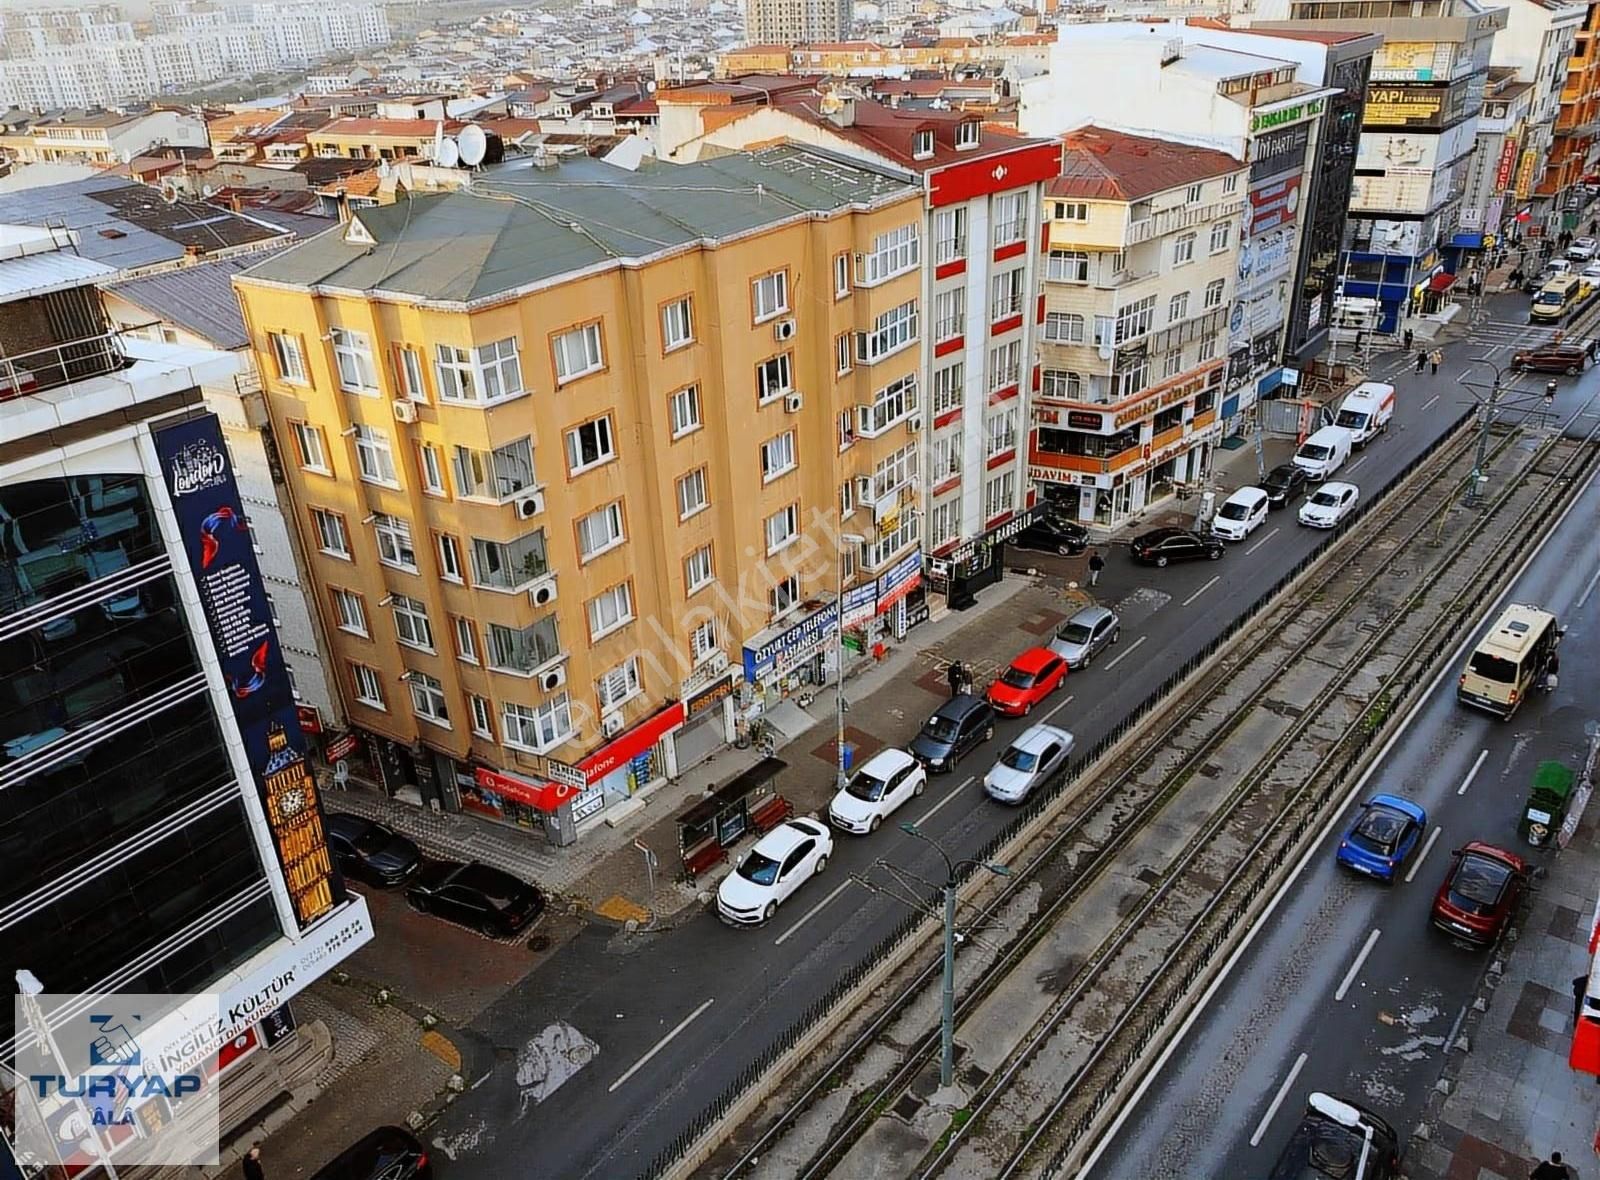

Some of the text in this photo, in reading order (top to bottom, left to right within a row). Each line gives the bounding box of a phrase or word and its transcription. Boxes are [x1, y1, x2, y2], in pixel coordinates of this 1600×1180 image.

[1370, 91, 1404, 103] YAPI
[173, 452, 225, 497] London
[159, 1018, 226, 1072] İNGİLİZ
[229, 971, 295, 1024] KÜLTÜR
[175, 1036, 224, 1074] YABANCI
[244, 997, 279, 1026] KURSU
